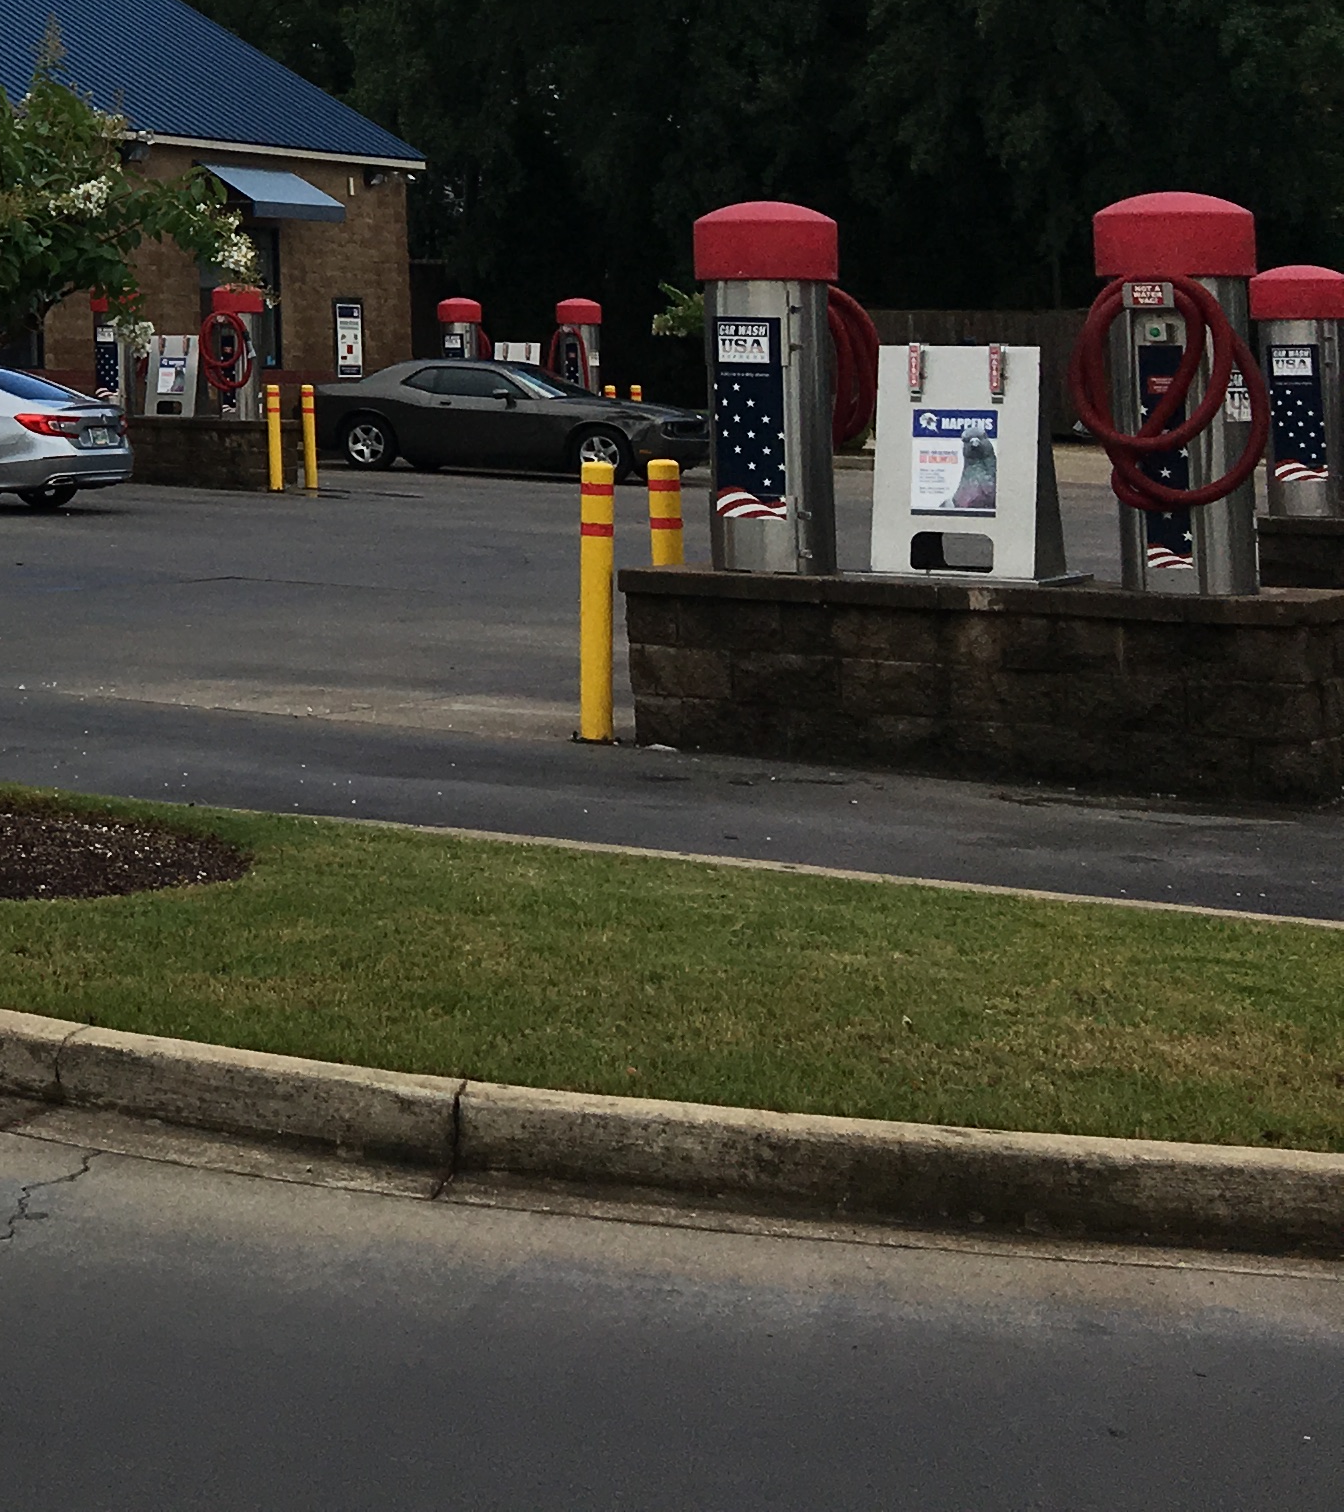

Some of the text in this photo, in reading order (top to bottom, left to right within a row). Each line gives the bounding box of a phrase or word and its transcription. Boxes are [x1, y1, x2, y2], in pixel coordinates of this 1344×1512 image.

[719, 325, 766, 336] CAR WASH
[720, 338, 765, 354] USA
[1274, 359, 1309, 369] USA
[941, 417, 993, 430] HAPPENS
